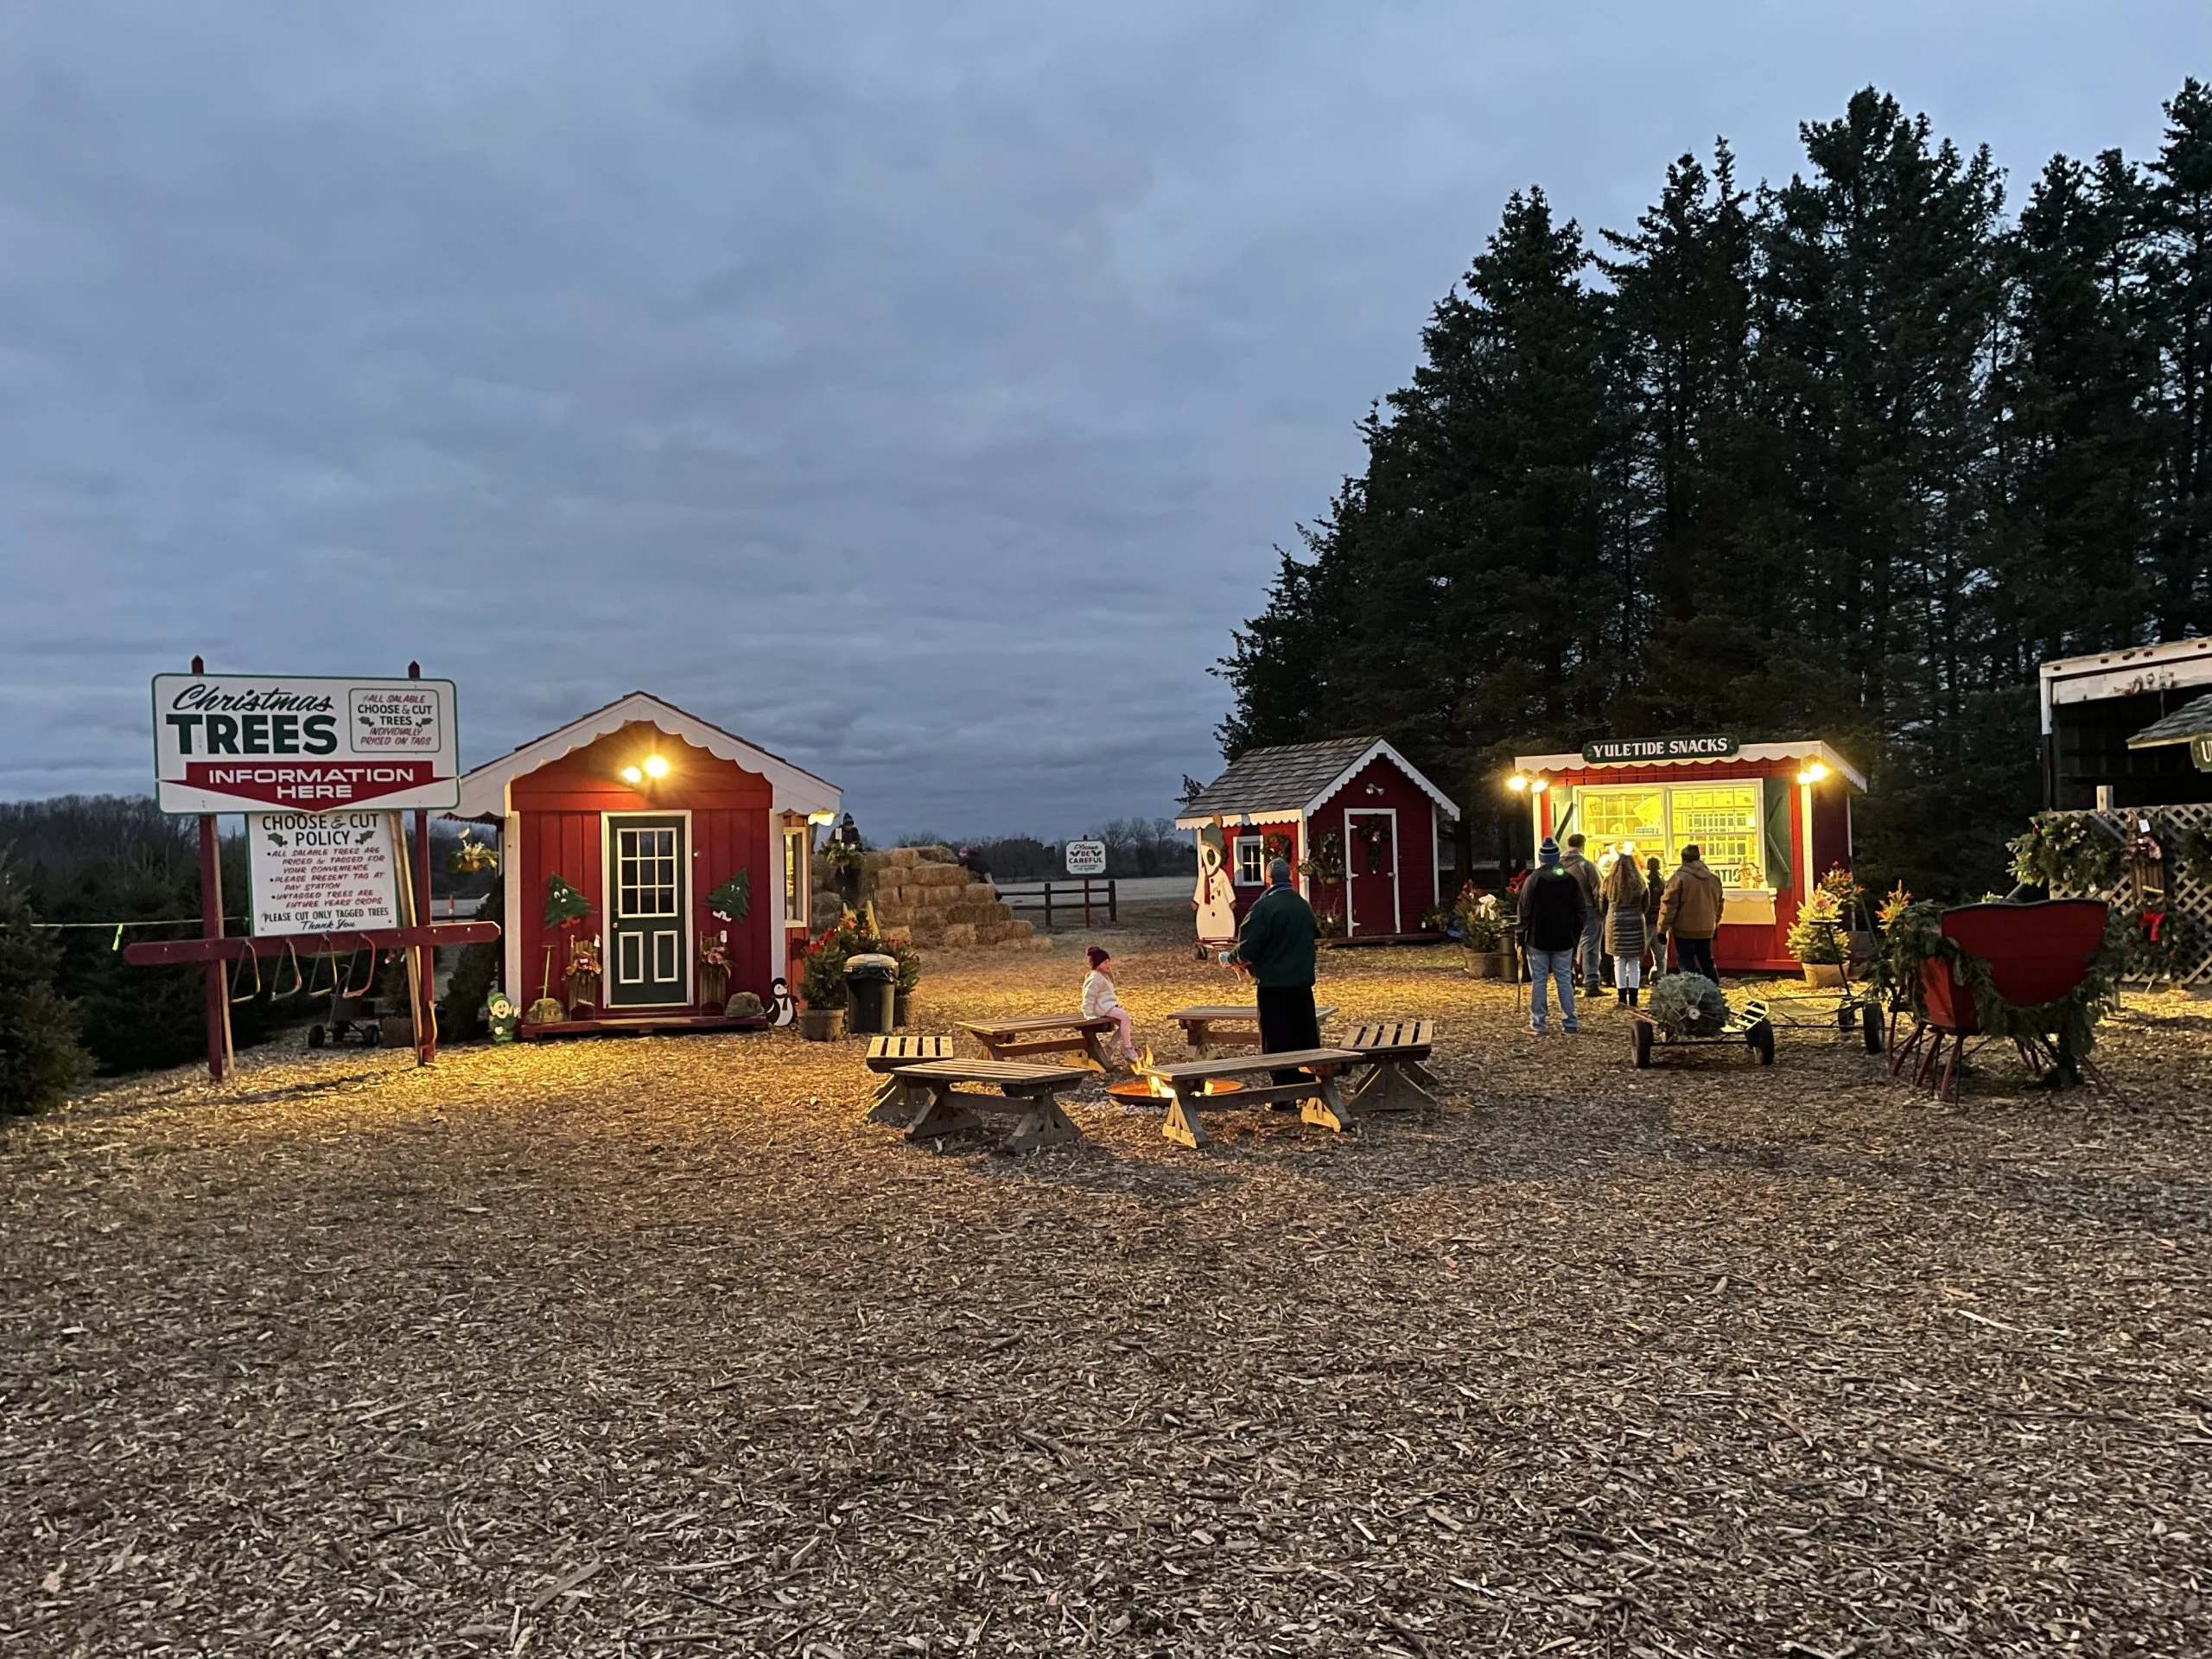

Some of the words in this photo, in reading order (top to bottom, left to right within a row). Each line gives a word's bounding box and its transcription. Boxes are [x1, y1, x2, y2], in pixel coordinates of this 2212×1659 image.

[172, 683, 334, 712] Christmas
[386, 695, 426, 703] SALABLE
[358, 704, 400, 714] CHOOSE
[401, 705, 410, 714] &
[412, 705, 432, 714] CUT
[379, 716, 412, 725] TREES
[166, 714, 338, 755] TREES
[370, 728, 423, 736] INDIVIDUALLY
[1592, 741, 1665, 757] YULETIDE
[1669, 738, 1727, 753] SNACKS
[208, 768, 415, 784] INFORMATION
[276, 785, 353, 799] HERE
[263, 814, 327, 830] CHOOSE
[330, 815, 346, 830] &
[350, 813, 379, 828] CUT
[296, 830, 350, 846] POLICY
[311, 864, 369, 873] CONVENIENCE
[276, 892, 321, 900] UNTAGGED
[285, 900, 320, 909] FUTURE
[264, 912, 291, 923] PLEASE
[295, 912, 308, 920] CUT
[313, 910, 333, 919] ONLY
[335, 908, 365, 918] TAGGED
[368, 907, 389, 917] TREES
[301, 921, 335, 930] Thank
[335, 919, 356, 929] You
